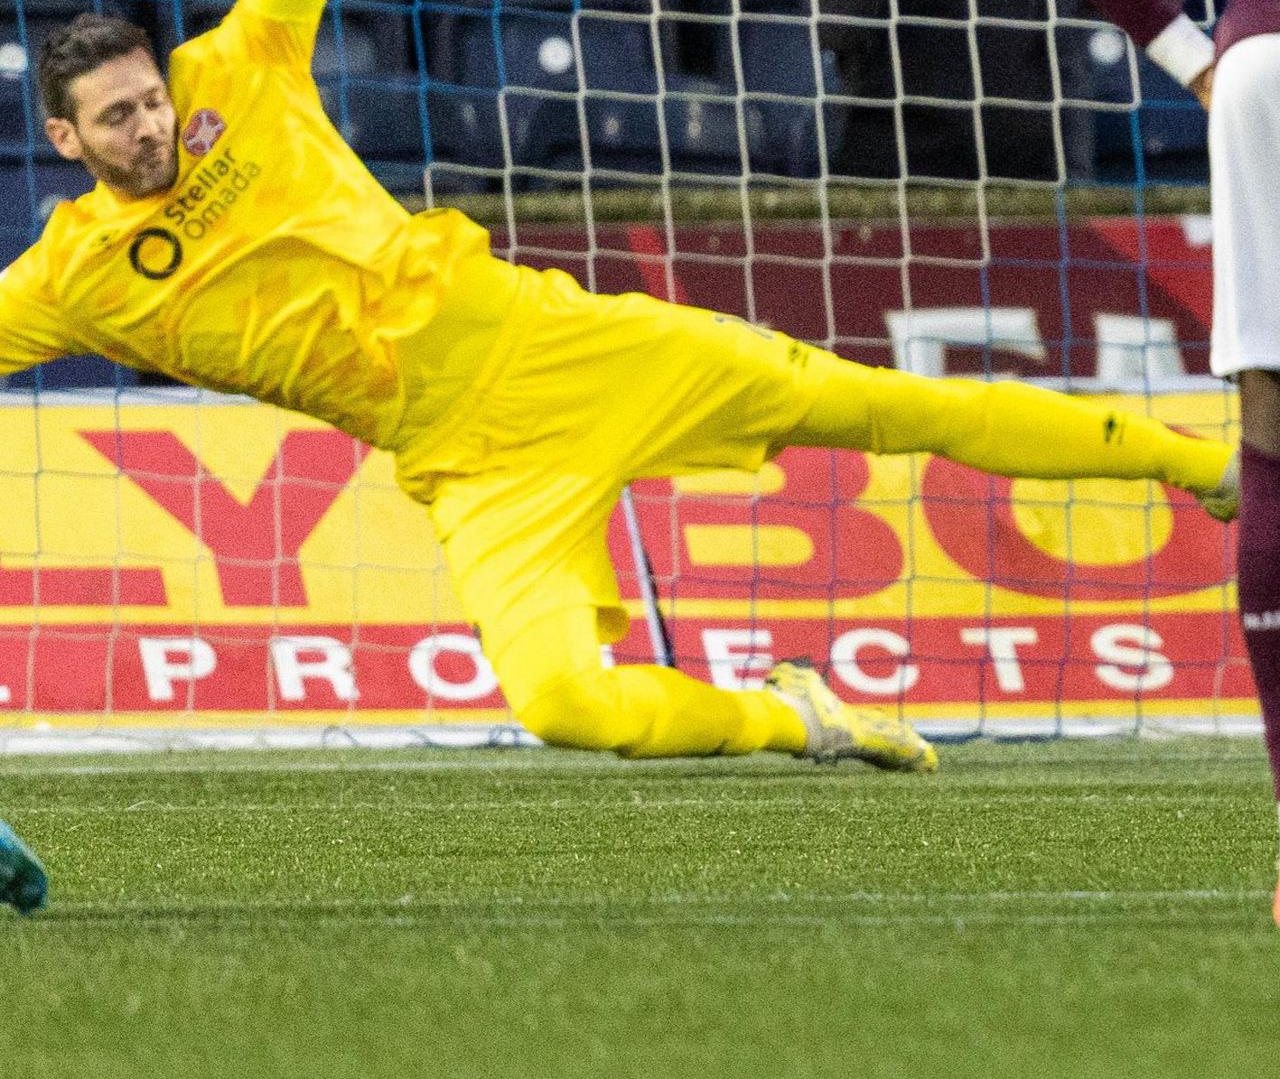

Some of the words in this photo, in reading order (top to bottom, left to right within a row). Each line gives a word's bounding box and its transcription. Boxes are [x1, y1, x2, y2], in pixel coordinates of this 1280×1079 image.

[164, 148, 236, 226] Stellar
[183, 162, 261, 240] Omada
[138, 623, 1175, 703] PROECTS
